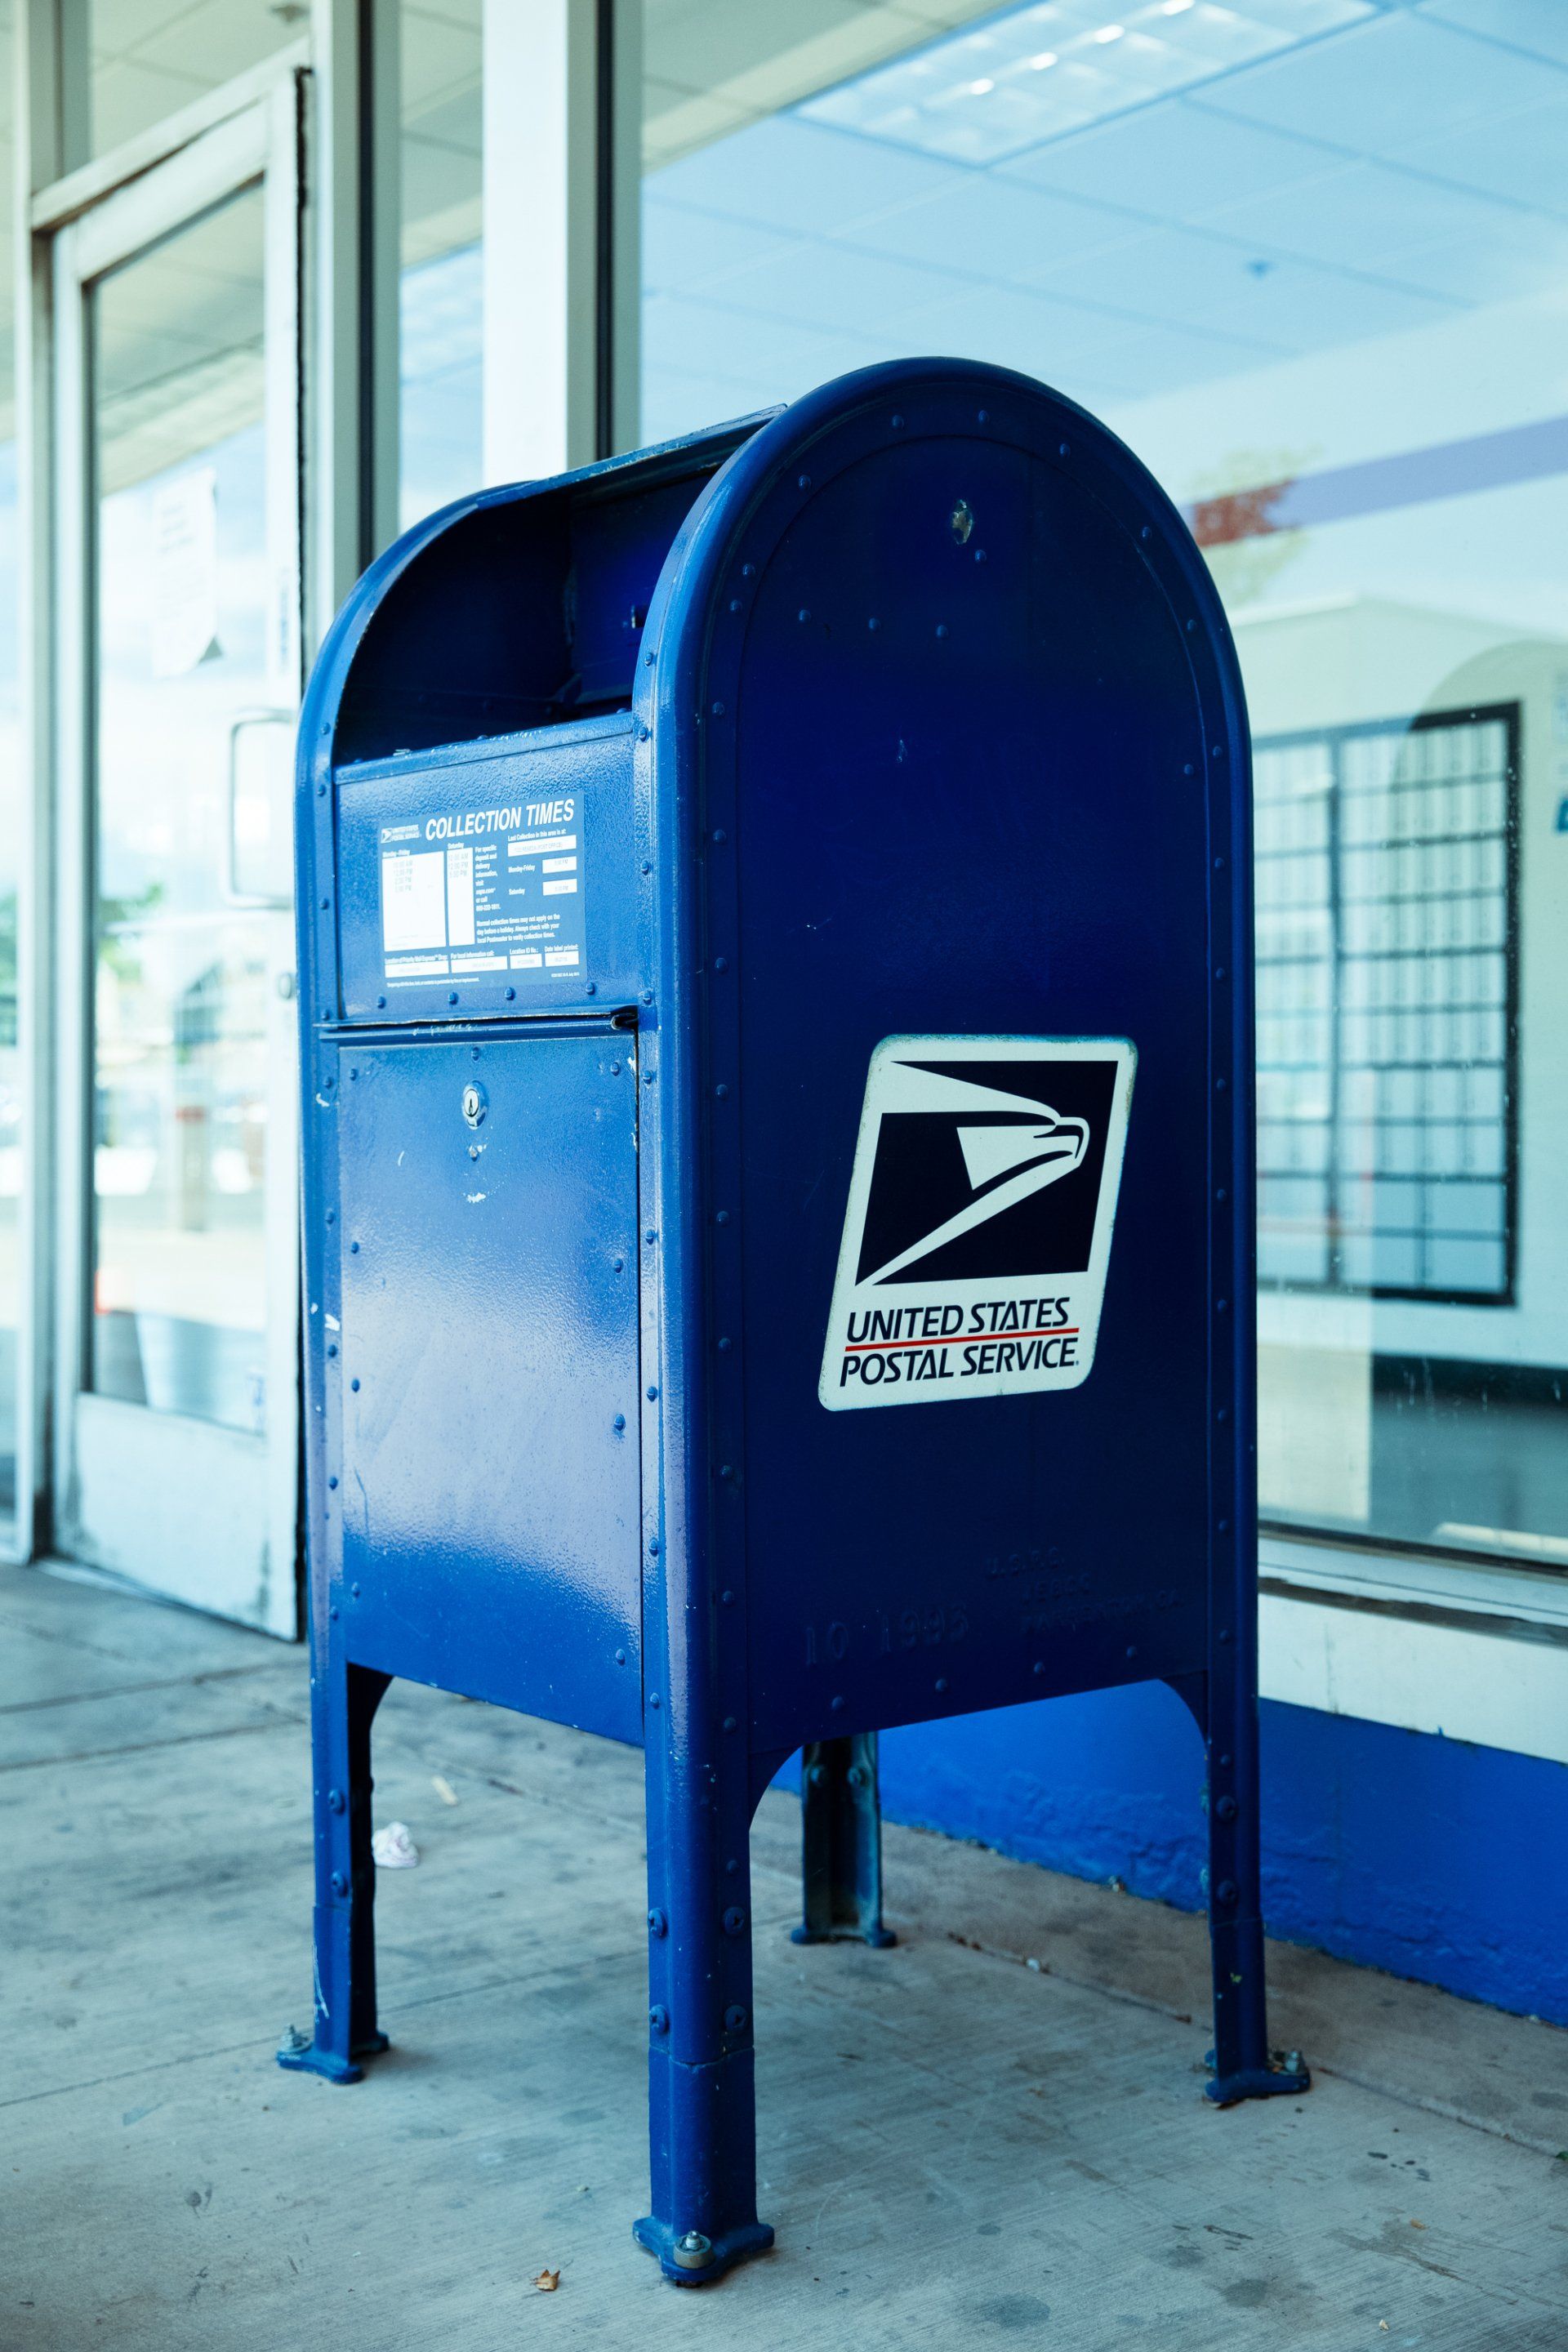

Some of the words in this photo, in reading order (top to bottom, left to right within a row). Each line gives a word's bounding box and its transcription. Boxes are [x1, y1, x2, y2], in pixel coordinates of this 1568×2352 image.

[425, 806, 521, 840] COLLECTION
[526, 799, 575, 826] TIMES
[517, 832, 535, 840] Collection
[491, 918, 508, 926] collection
[847, 1305, 964, 1343] UNITED
[969, 1297, 1070, 1334] STATES
[840, 1348, 954, 1388] POSTAL
